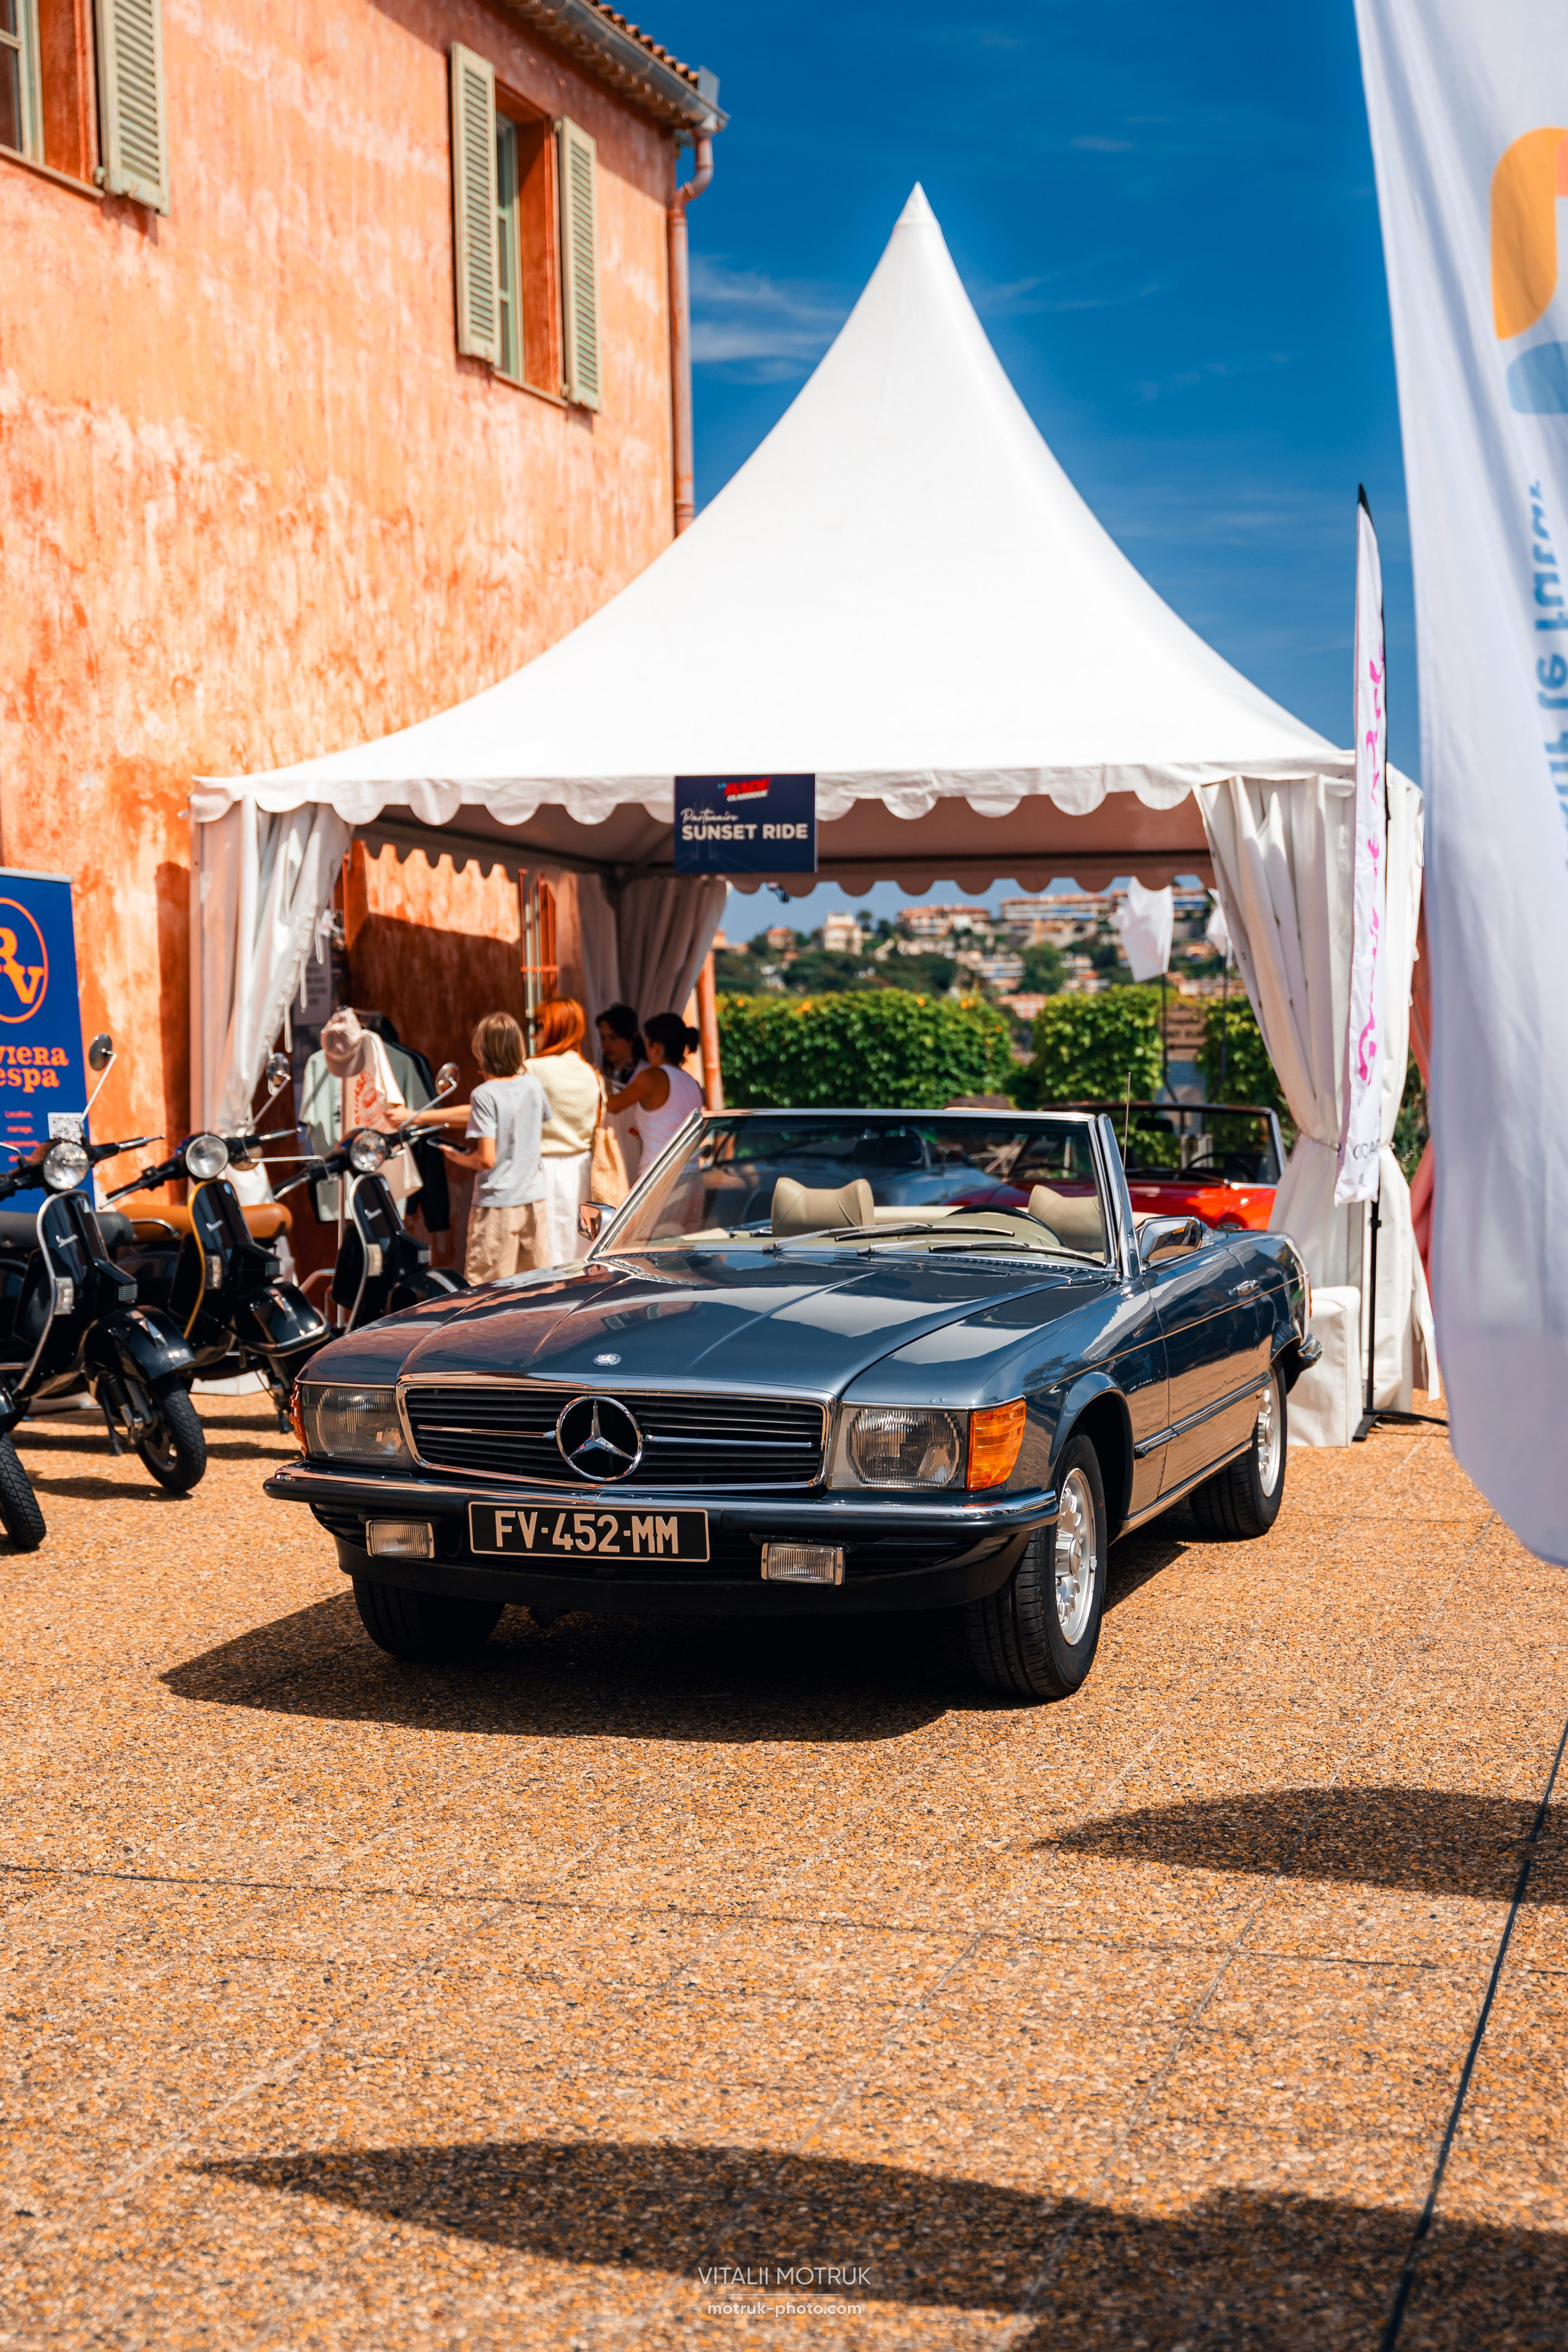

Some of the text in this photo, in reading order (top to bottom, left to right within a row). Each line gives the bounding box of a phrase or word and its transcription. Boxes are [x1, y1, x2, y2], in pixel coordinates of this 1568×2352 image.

[682, 823, 808, 840] SUNSET RIDE
[495, 1510, 679, 1554] FV-452-MM
